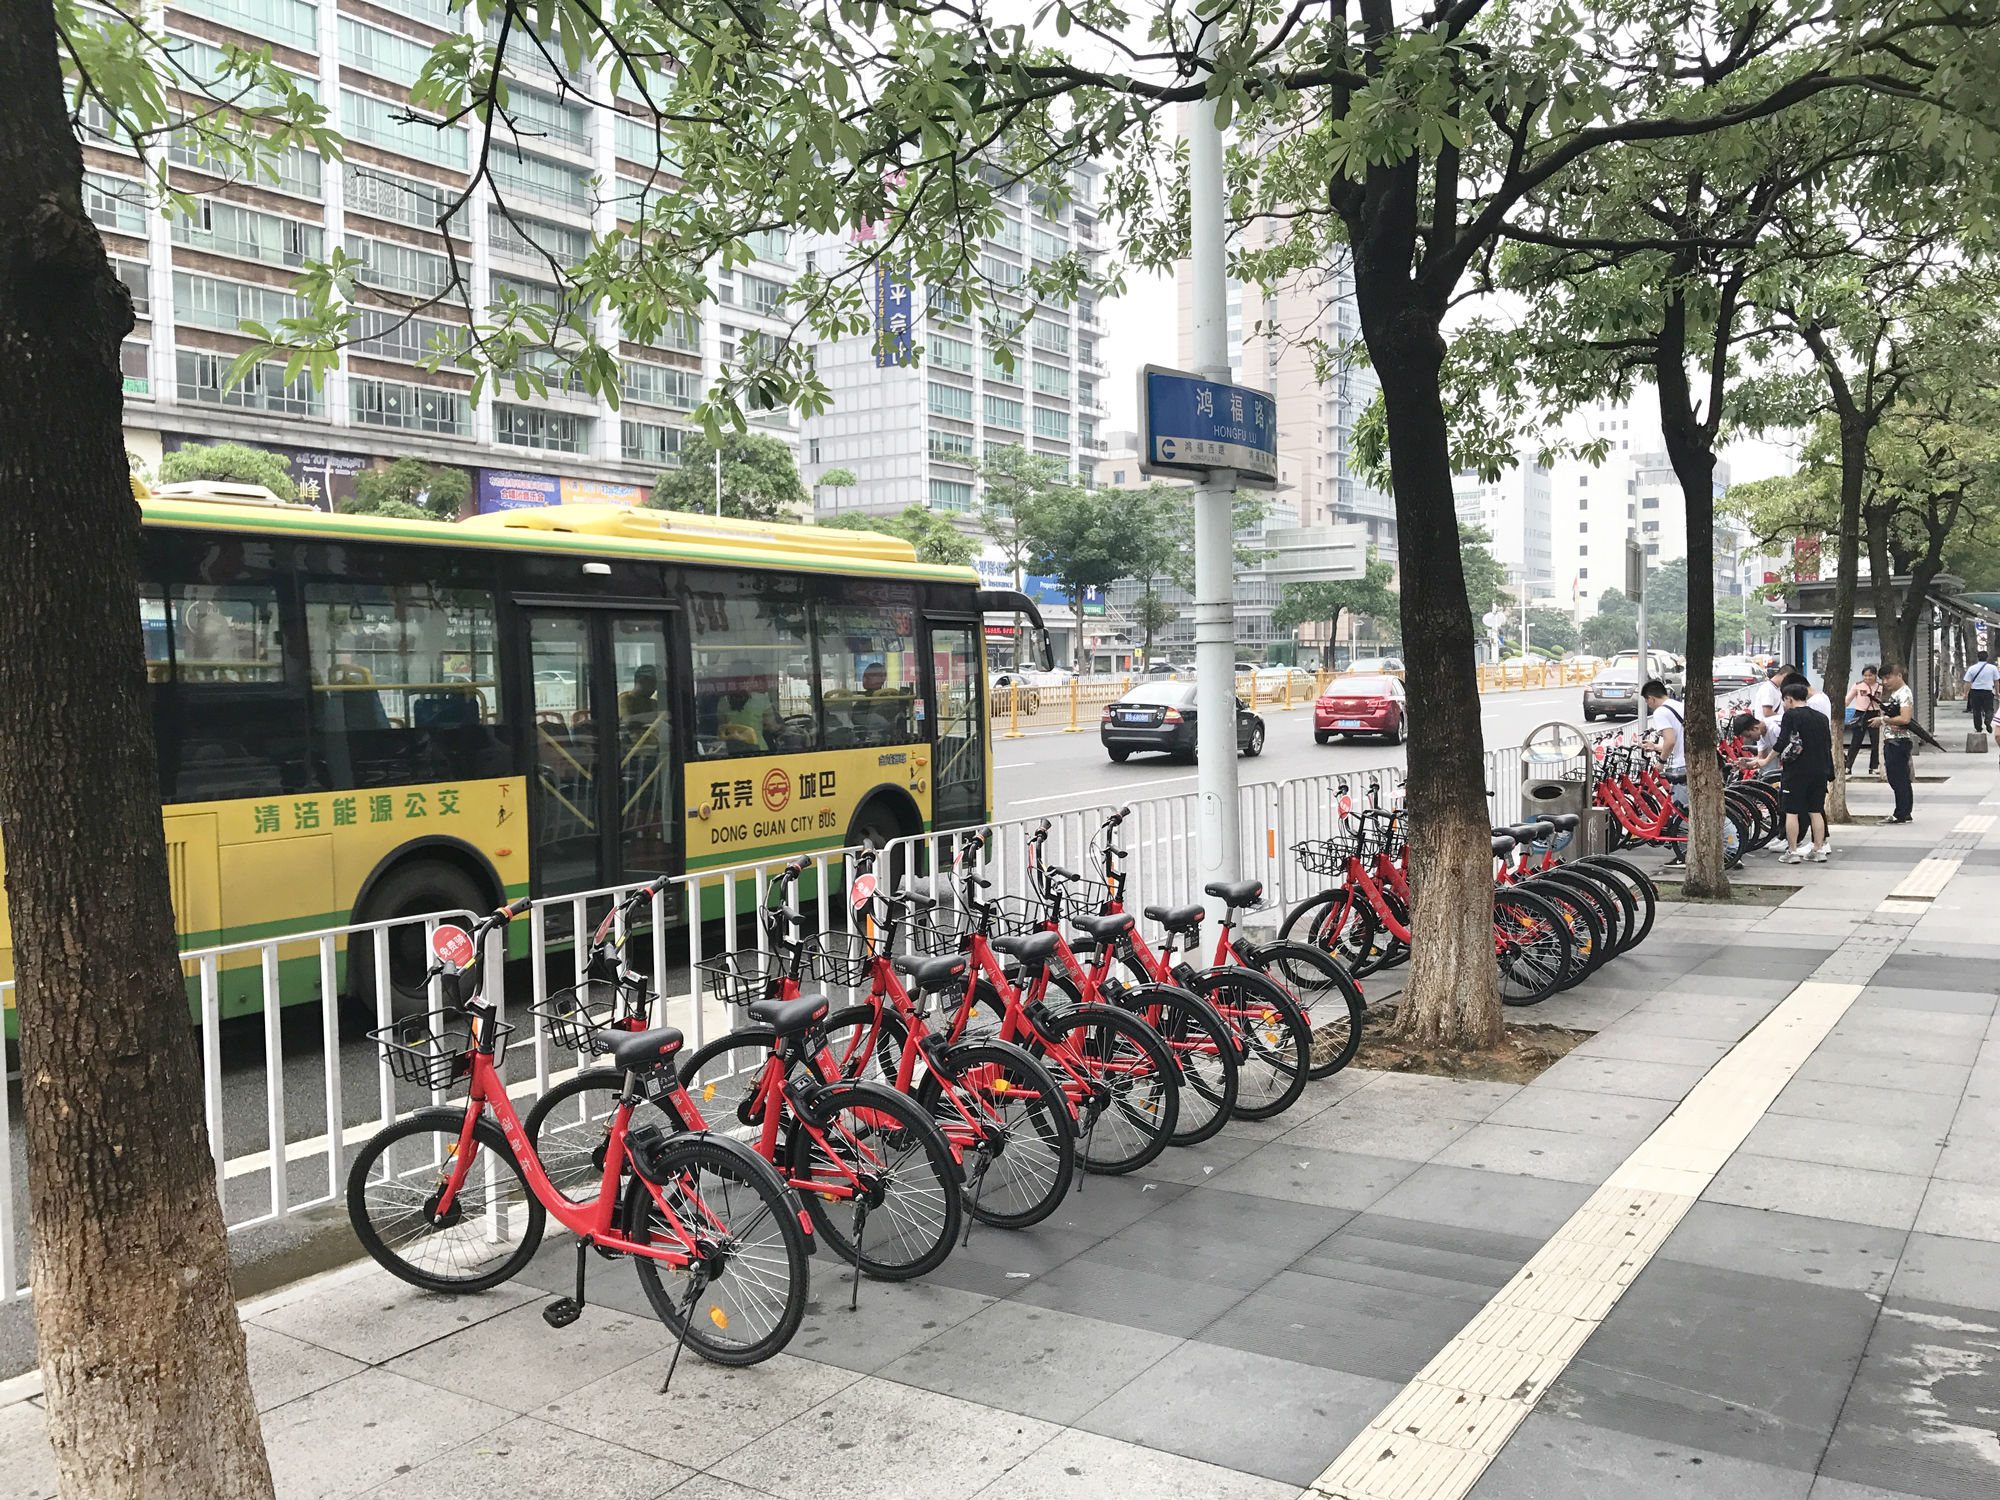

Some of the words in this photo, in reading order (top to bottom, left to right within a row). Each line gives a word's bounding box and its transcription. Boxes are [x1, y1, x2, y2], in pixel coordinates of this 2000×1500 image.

[1196, 388, 1265, 429] 鸿福路
[1213, 425, 1247, 441] HONGFU
[1249, 432, 1257, 444] LU
[498, 784, 510, 798] 下
[711, 779, 753, 811] 东莞
[798, 770, 836, 800] 城巴
[254, 789, 461, 834] 清洁能源公交
[711, 825, 748, 844] DONG
[753, 819, 787, 839] GUAN
[791, 815, 814, 833] CITY
[818, 811, 836, 829] BUS
[439, 933, 467, 959] 免费骑
